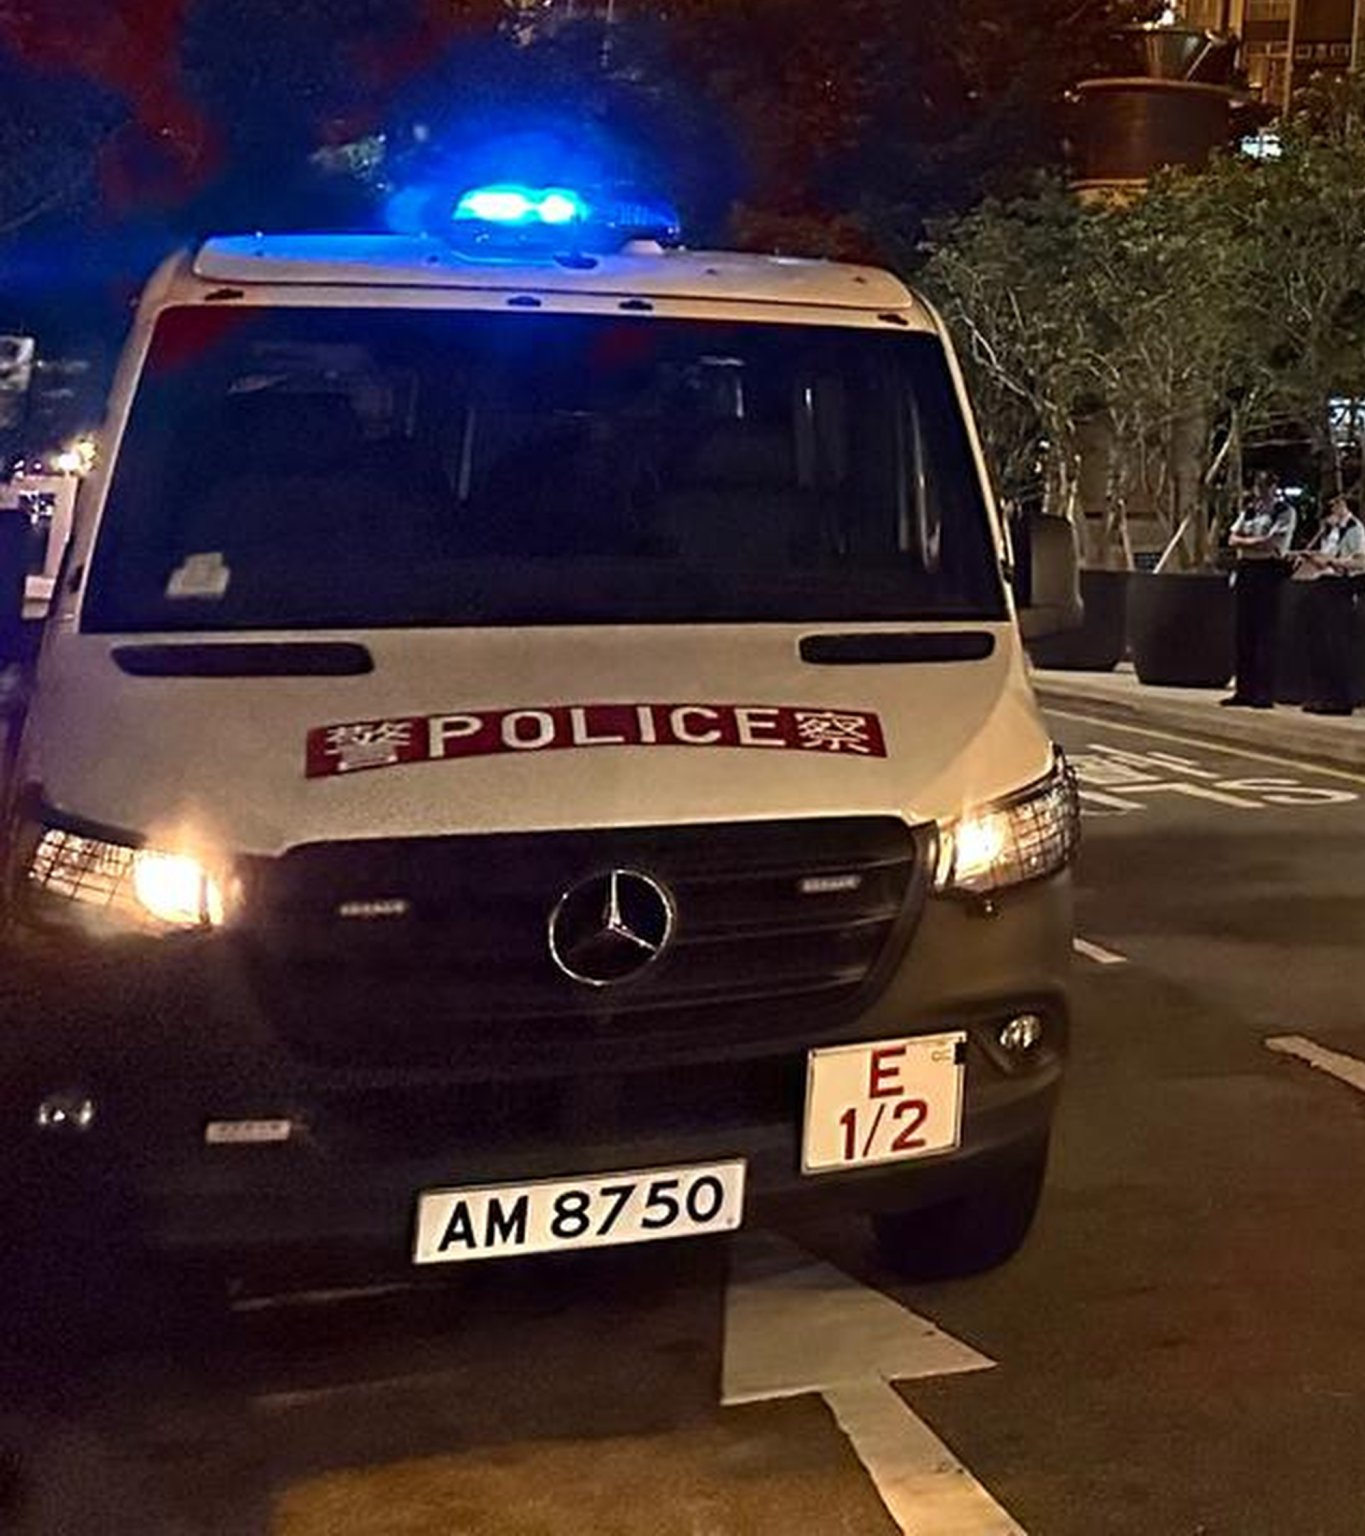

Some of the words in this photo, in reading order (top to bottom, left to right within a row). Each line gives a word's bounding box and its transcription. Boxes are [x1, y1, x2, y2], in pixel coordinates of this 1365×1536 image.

[427, 706, 787, 759] POLICE
[794, 710, 869, 754] 察
[868, 1044, 908, 1099] E
[839, 1099, 929, 1161] 1/2
[437, 1195, 530, 1252] AM
[550, 1176, 725, 1239] 8750
